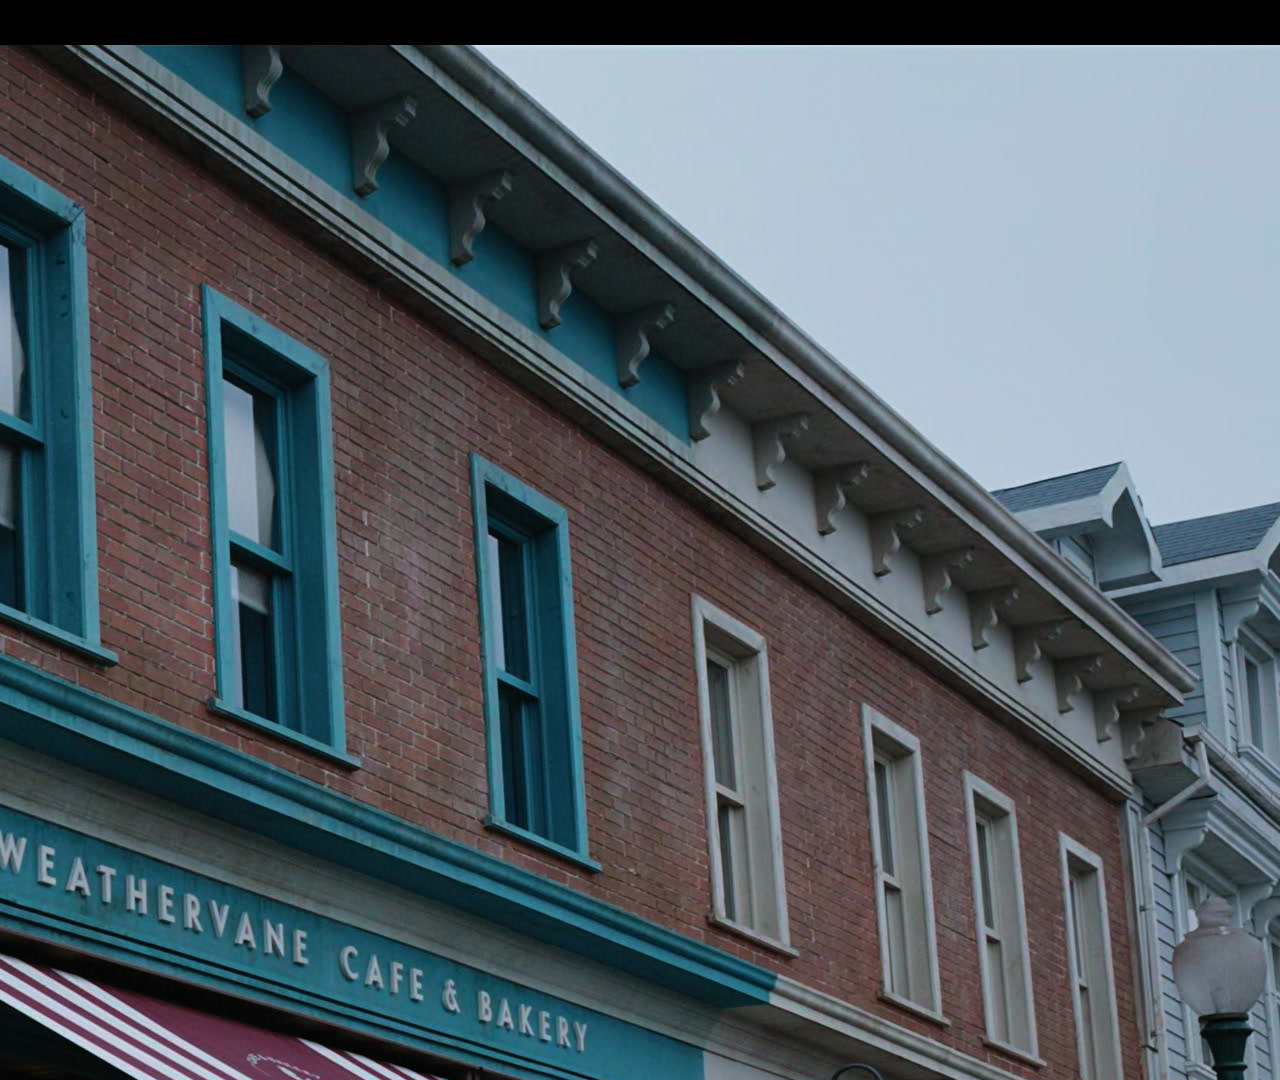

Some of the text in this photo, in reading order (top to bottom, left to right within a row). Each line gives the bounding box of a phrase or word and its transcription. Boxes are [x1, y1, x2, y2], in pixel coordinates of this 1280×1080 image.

[340, 945, 424, 1002] CAFE
[442, 979, 461, 1013] &
[477, 990, 587, 1052] BAKERY
